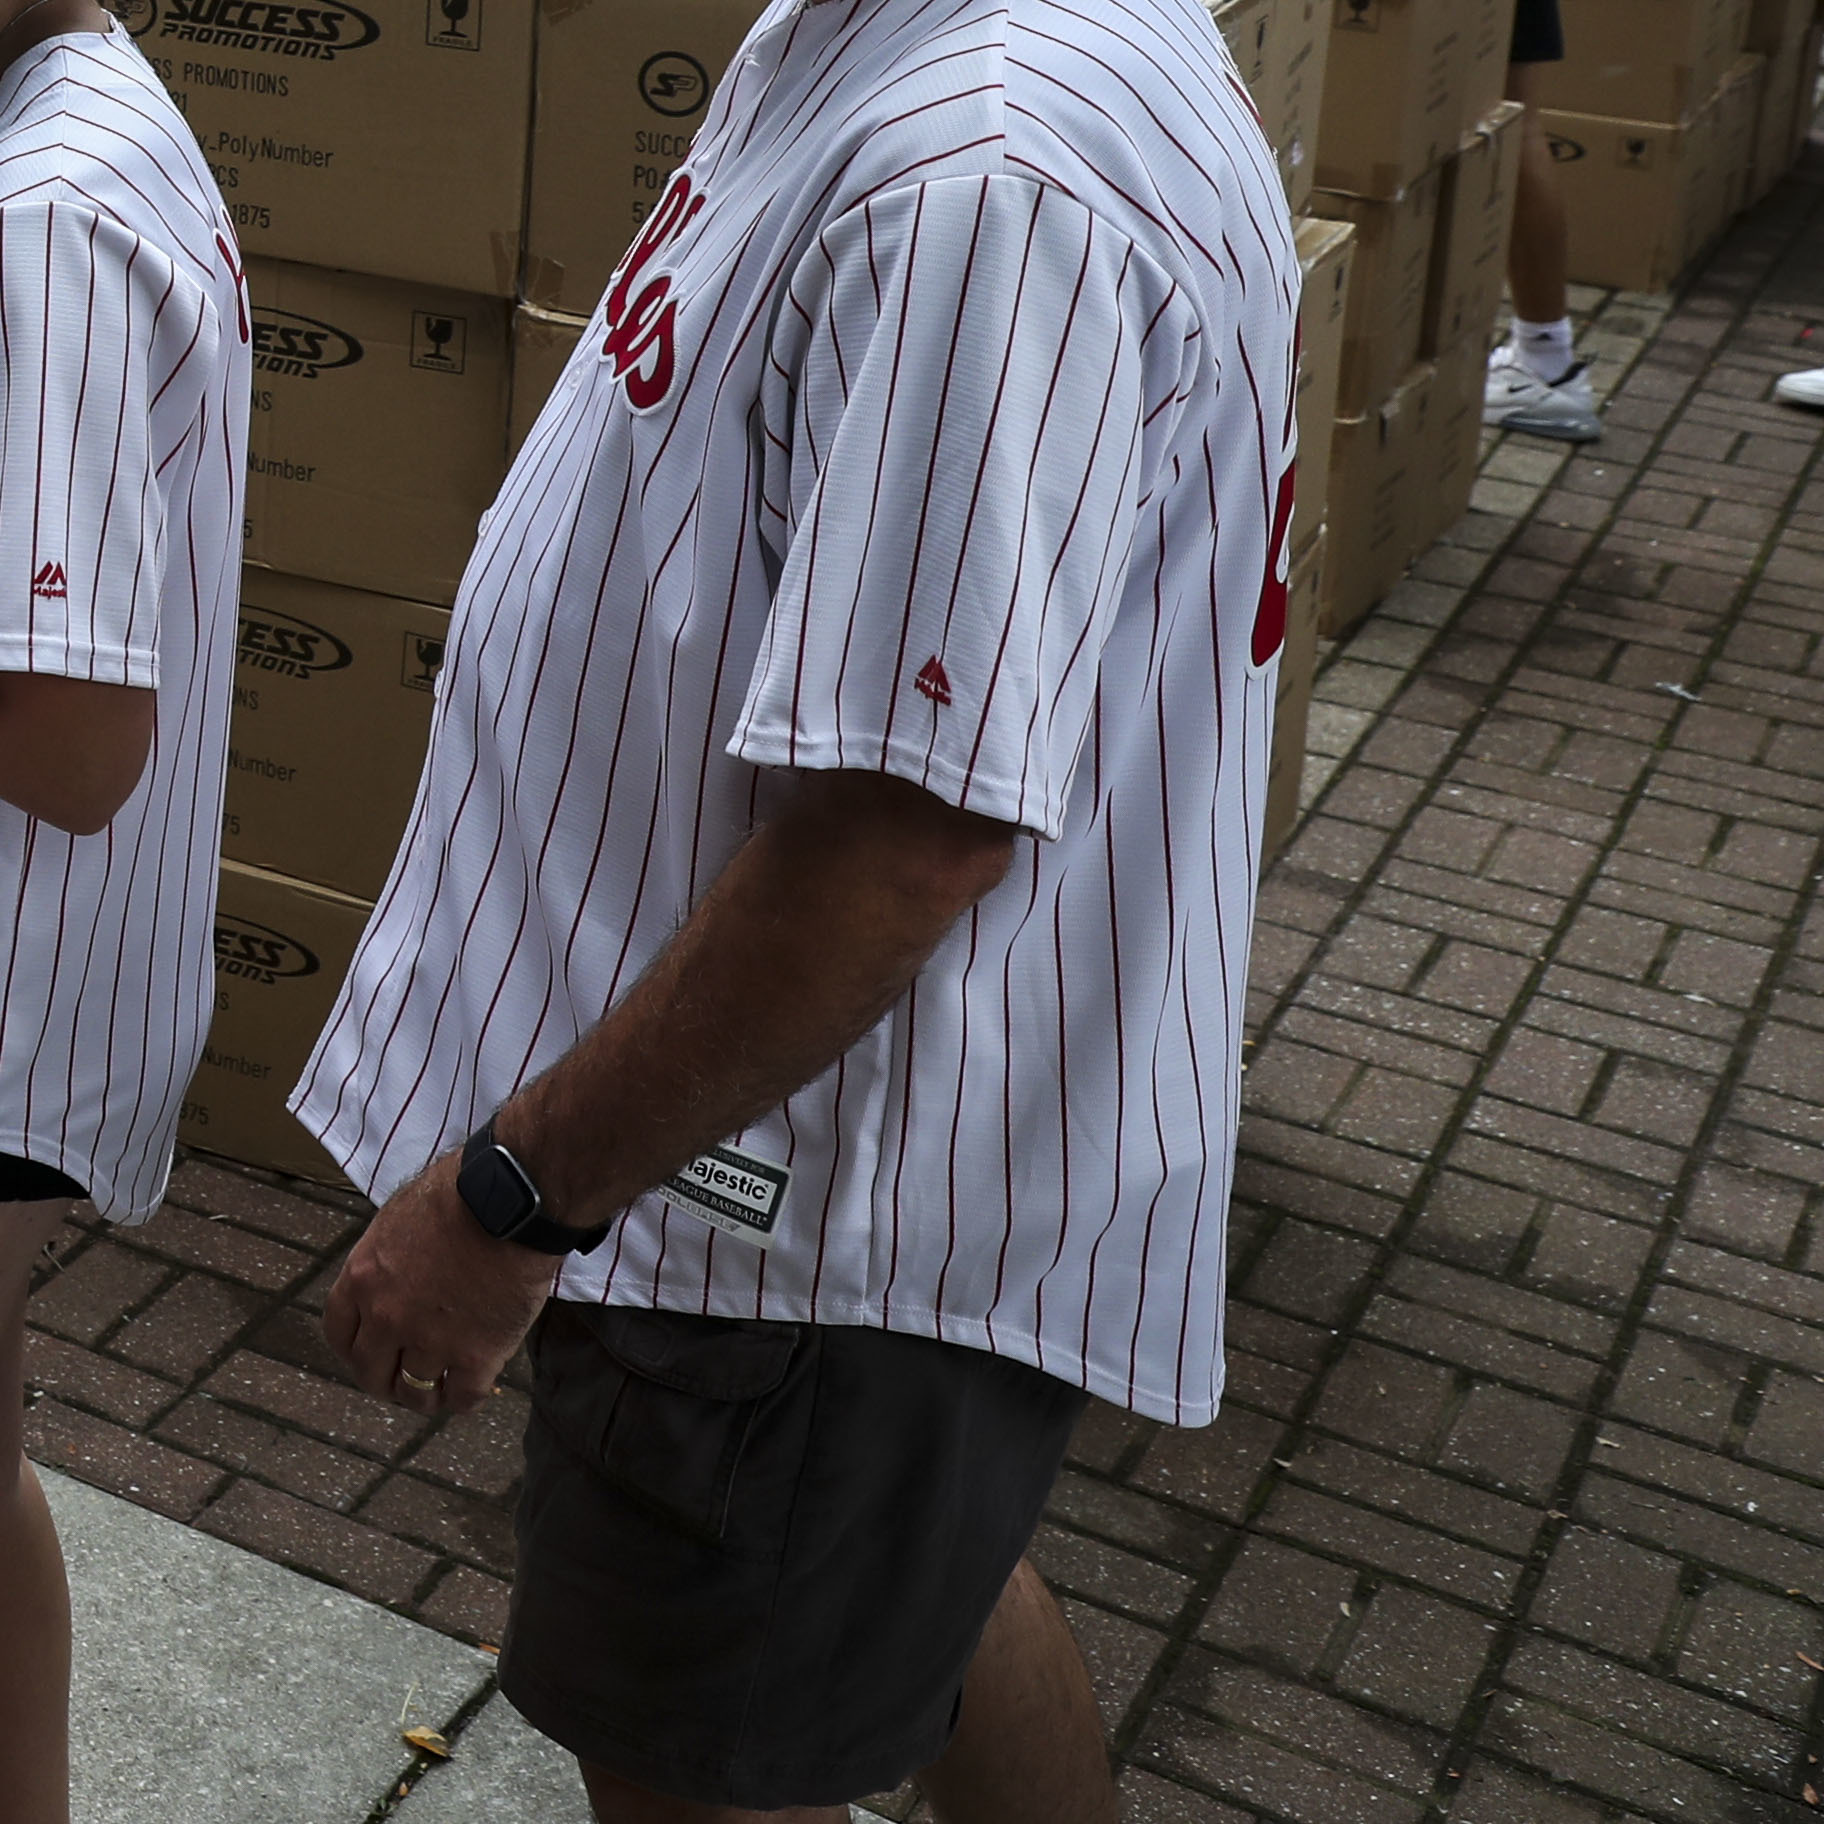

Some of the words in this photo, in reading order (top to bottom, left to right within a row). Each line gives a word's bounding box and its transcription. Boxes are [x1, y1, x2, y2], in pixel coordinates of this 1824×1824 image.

[159, 21, 338, 62] PROMOTIONS
[182, 61, 290, 98] PROMOTIONS
[710, 1196, 768, 1226] BASEBALL
